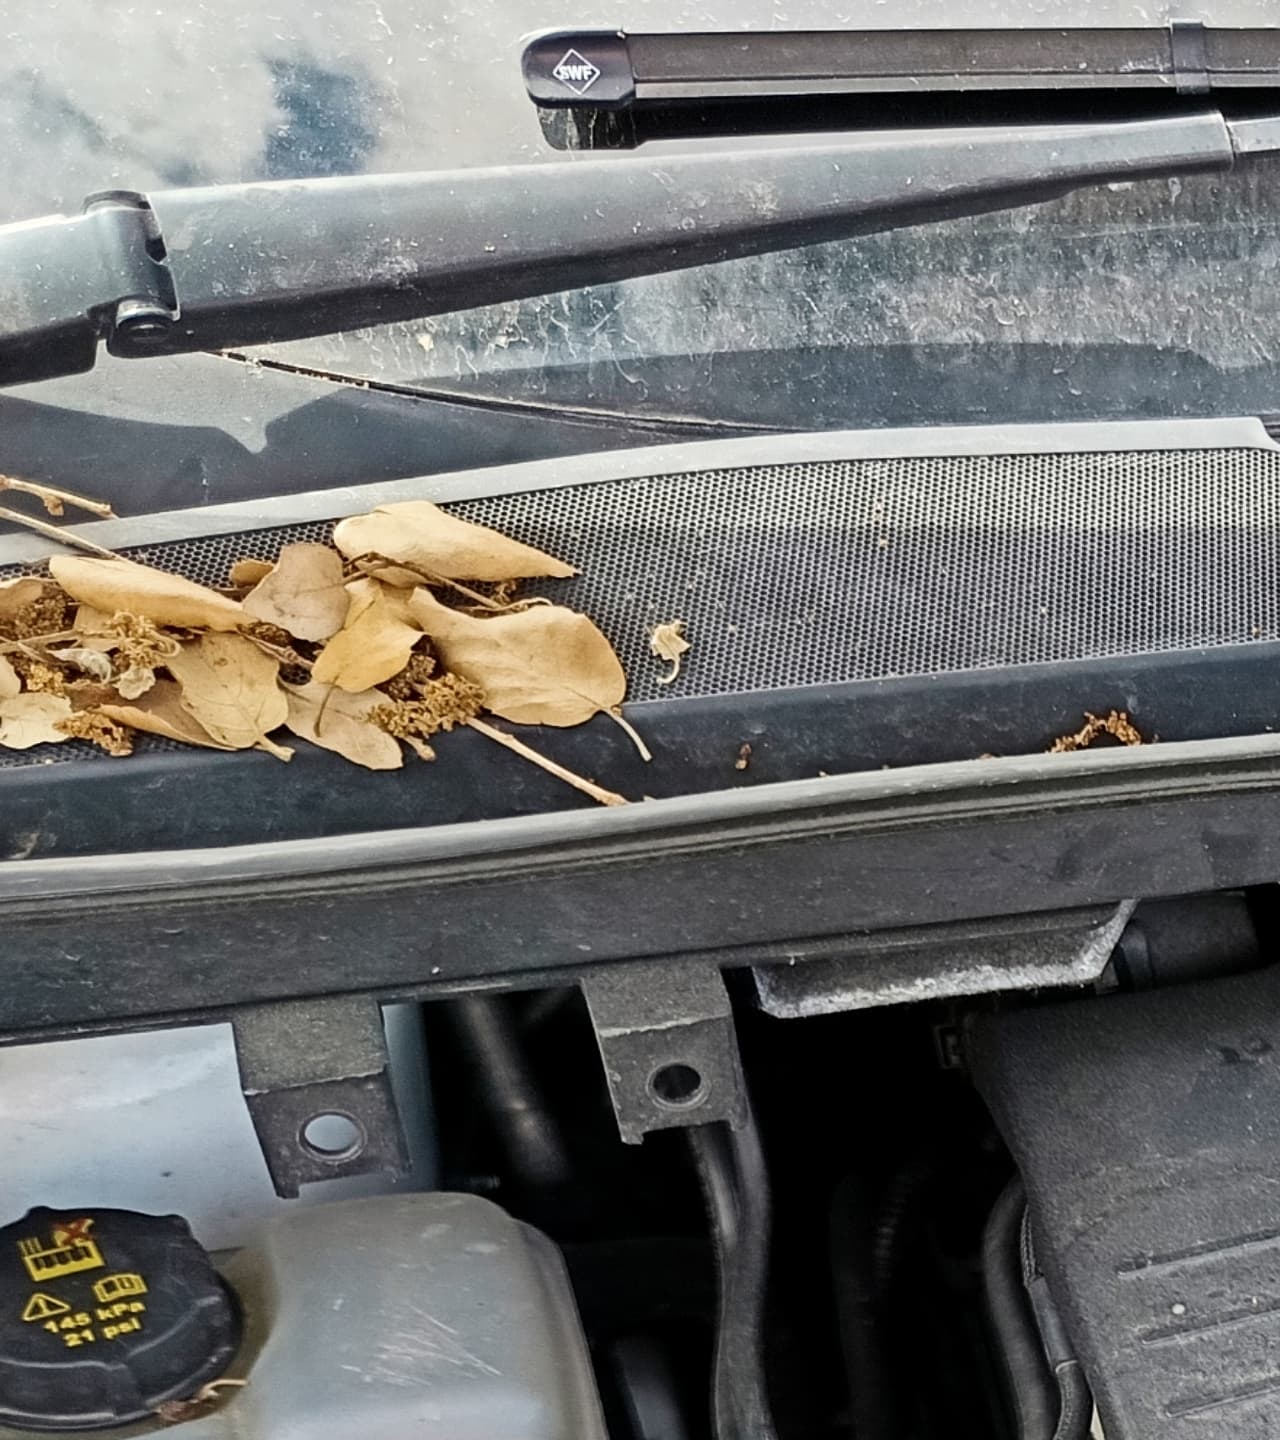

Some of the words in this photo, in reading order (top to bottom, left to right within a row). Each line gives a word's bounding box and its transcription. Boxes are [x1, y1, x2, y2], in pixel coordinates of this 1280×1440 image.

[558, 65, 593, 80] SWF
[44, 1312, 91, 1333] 145
[97, 1302, 146, 1321] kPa
[63, 1329, 95, 1348] 21
[103, 1317, 141, 1340] psi
